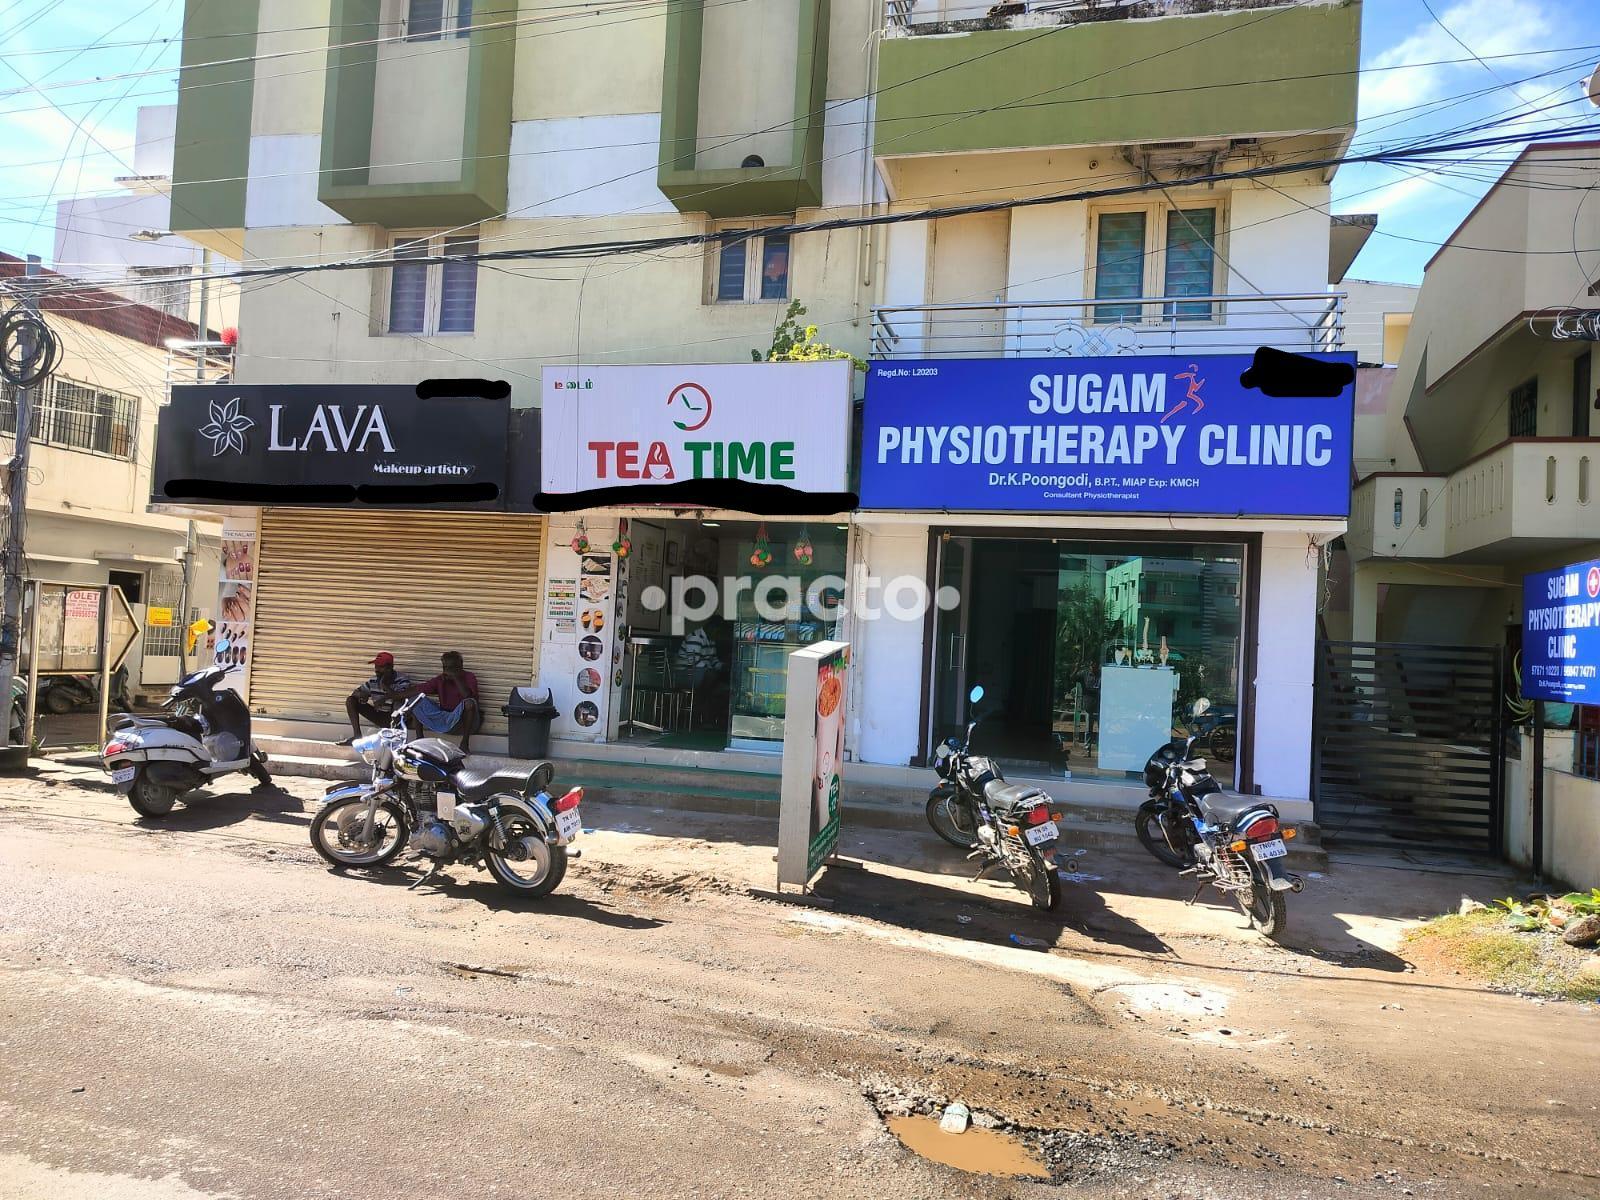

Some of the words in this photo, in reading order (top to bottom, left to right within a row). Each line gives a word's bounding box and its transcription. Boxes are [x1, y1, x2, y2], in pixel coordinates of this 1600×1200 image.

[912, 367, 938, 376] L20203
[1028, 372, 1166, 415] SUGAM
[268, 404, 396, 452] LAVA
[877, 424, 1187, 465] PHYSIOTHERAPY
[1199, 423, 1333, 467] CLINIC
[373, 463, 422, 475] Makeup
[424, 463, 471, 476] artistry
[588, 441, 675, 480] TEA
[684, 441, 795, 480] TIME
[988, 472, 1092, 488] Dr.K.Poongodi,
[1122, 478, 1146, 487] MIAP
[1148, 478, 1168, 488] Exp:
[1170, 478, 1200, 488] KMCH
[1043, 491, 1082, 499] Consultant
[1083, 491, 1140, 500] Physiotherapist
[1547, 573, 1579, 600] SUGAM
[1528, 602, 1600, 631] PHYSIOTHERAPY
[1547, 634, 1577, 658] CLINIC
